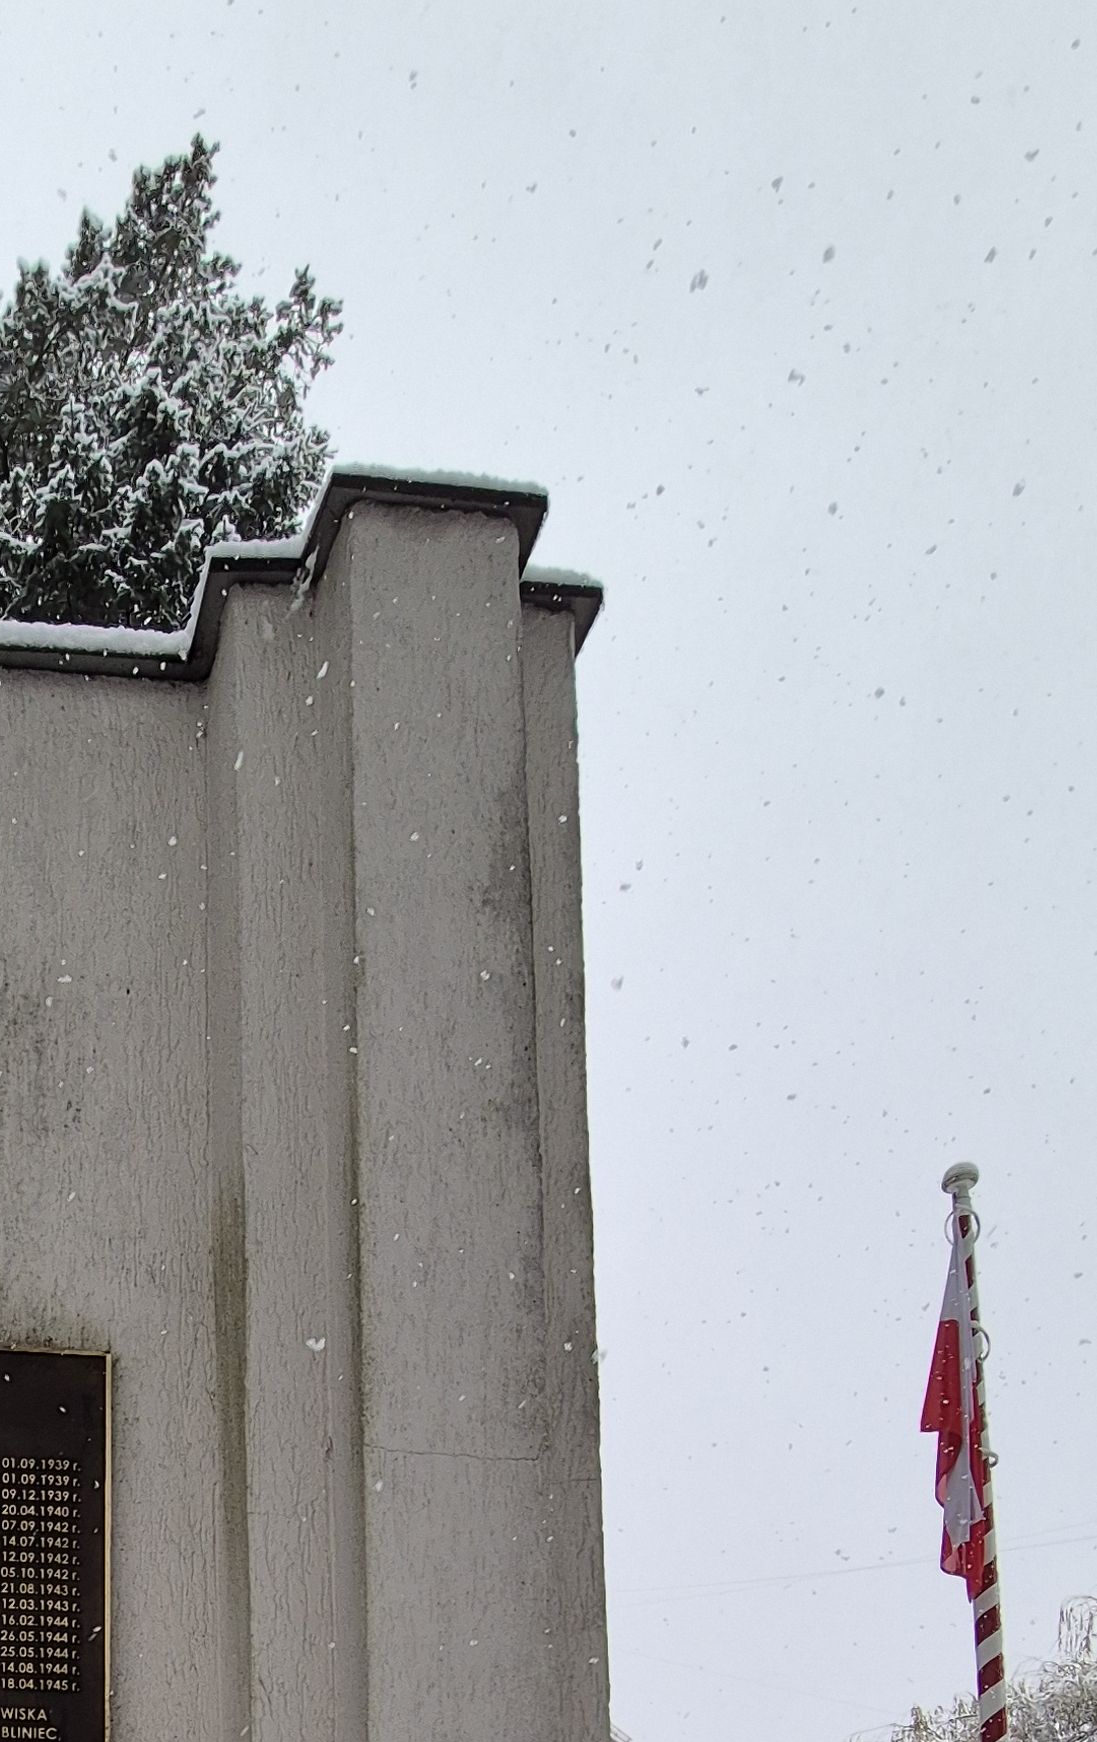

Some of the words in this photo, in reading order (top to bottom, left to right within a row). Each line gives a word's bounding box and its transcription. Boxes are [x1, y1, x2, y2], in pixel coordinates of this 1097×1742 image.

[1, 1457, 70, 1471] 01.09.1939
[73, 1462, 82, 1471] r.
[1, 1473, 70, 1486] 01.09.1939
[72, 1478, 81, 1487] r.
[1, 1489, 69, 1502] 09.12.1939
[72, 1494, 82, 1502] r.
[1, 1505, 69, 1517] 20.04.1940
[72, 1509, 81, 1518] r.
[1, 1520, 69, 1533] 07.09.1942
[72, 1525, 81, 1534] r.
[2, 1535, 69, 1549] 14.07.1942
[72, 1540, 81, 1550] r.
[2, 1551, 69, 1565] 12.09.1942
[71, 1556, 81, 1565] r.
[0, 1567, 69, 1580] 05.10.1942
[71, 1572, 81, 1581] r.
[0, 1582, 68, 1596] 21.08.1943
[71, 1588, 81, 1596] r.
[1, 1598, 69, 1612] 12.03.1943
[72, 1603, 81, 1612] r.
[1, 1614, 69, 1628] 16.02.1944
[71, 1620, 81, 1628] r.
[0, 1630, 68, 1644] 26.05.1944
[71, 1635, 81, 1644] r.
[0, 1646, 68, 1659] 25.05.1944
[72, 1651, 81, 1660] r.
[0, 1662, 68, 1675] 14.08.1944
[72, 1667, 80, 1676] r.
[1, 1678, 68, 1691] 18.04.1945
[72, 1683, 80, 1692] r.
